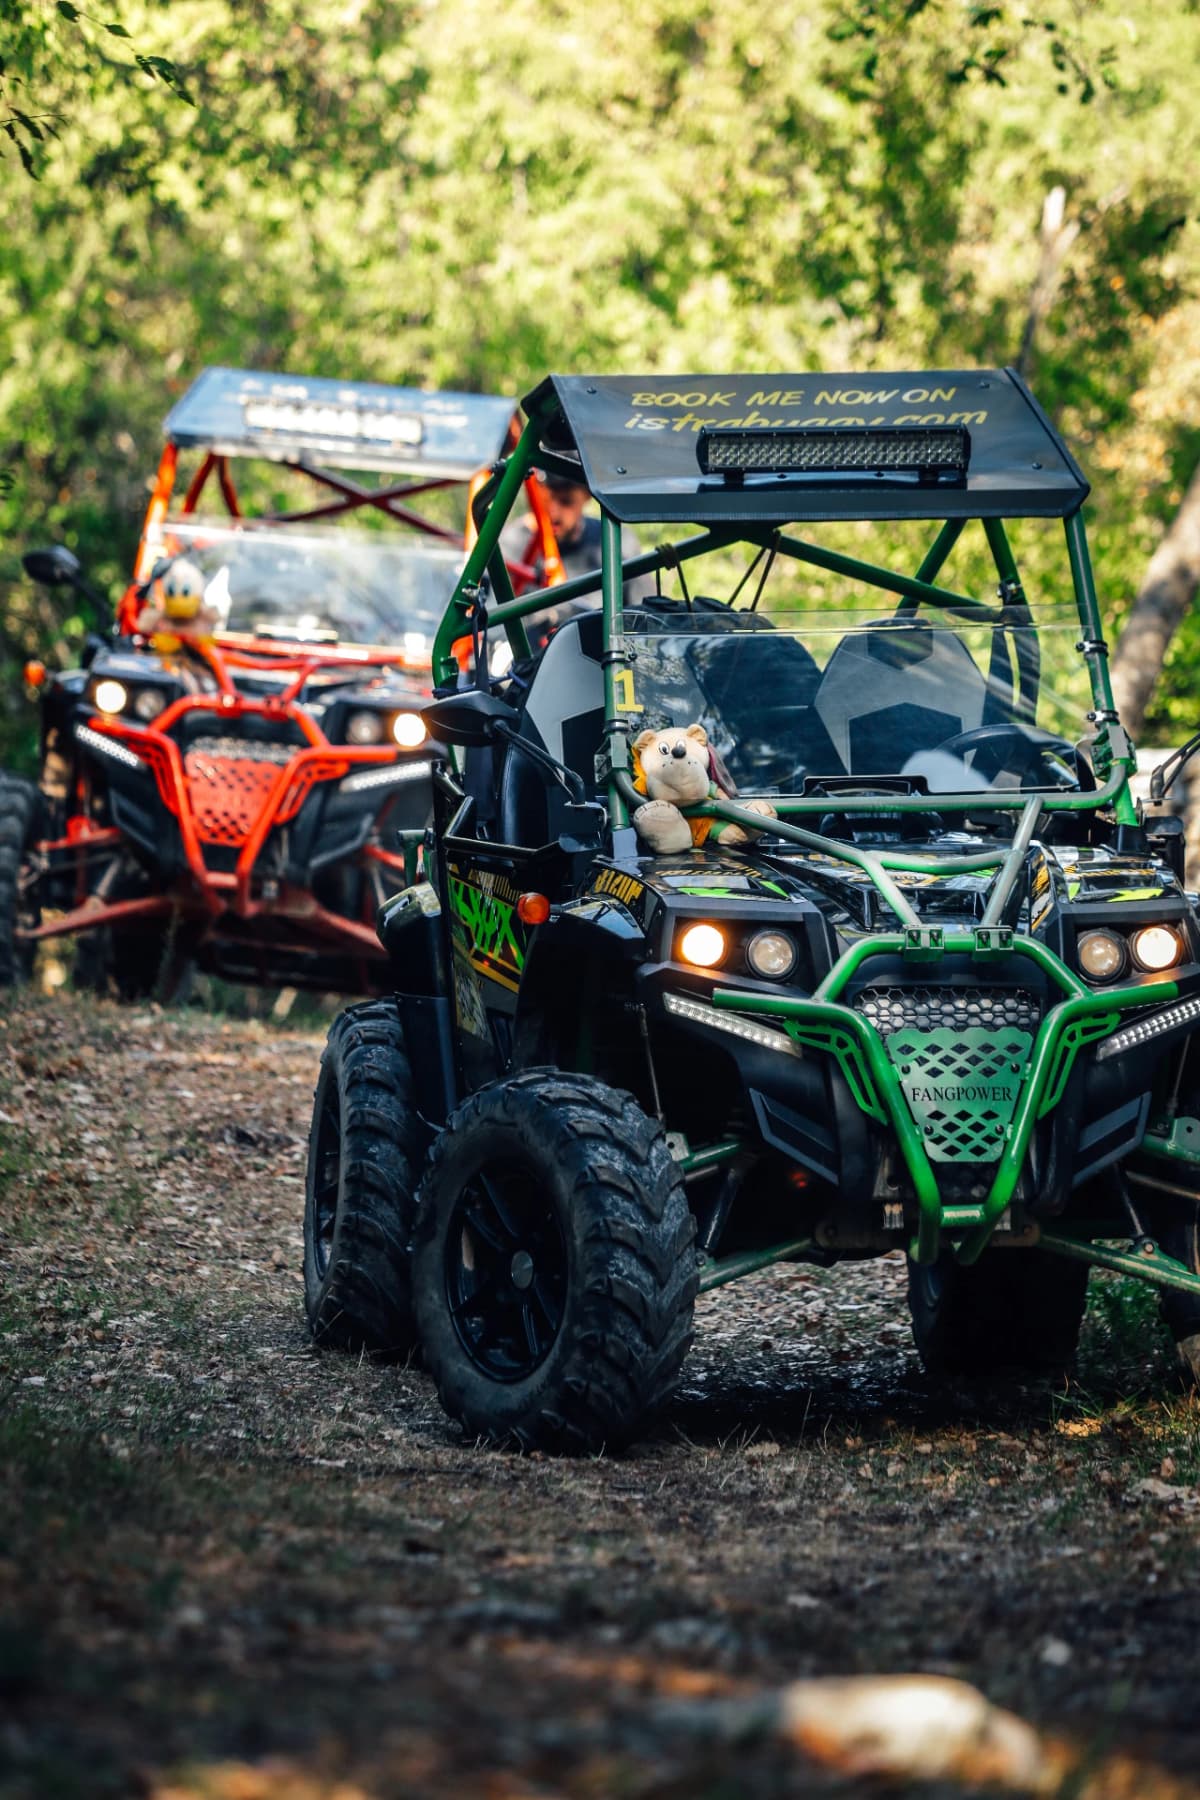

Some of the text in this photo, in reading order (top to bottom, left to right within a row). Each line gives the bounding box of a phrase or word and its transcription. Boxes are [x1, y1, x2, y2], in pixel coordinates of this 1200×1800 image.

[631, 386, 957, 407] BOOK ME NOW ON
[614, 669, 645, 713] 1
[911, 1086, 1013, 1102] FANGPOWER
